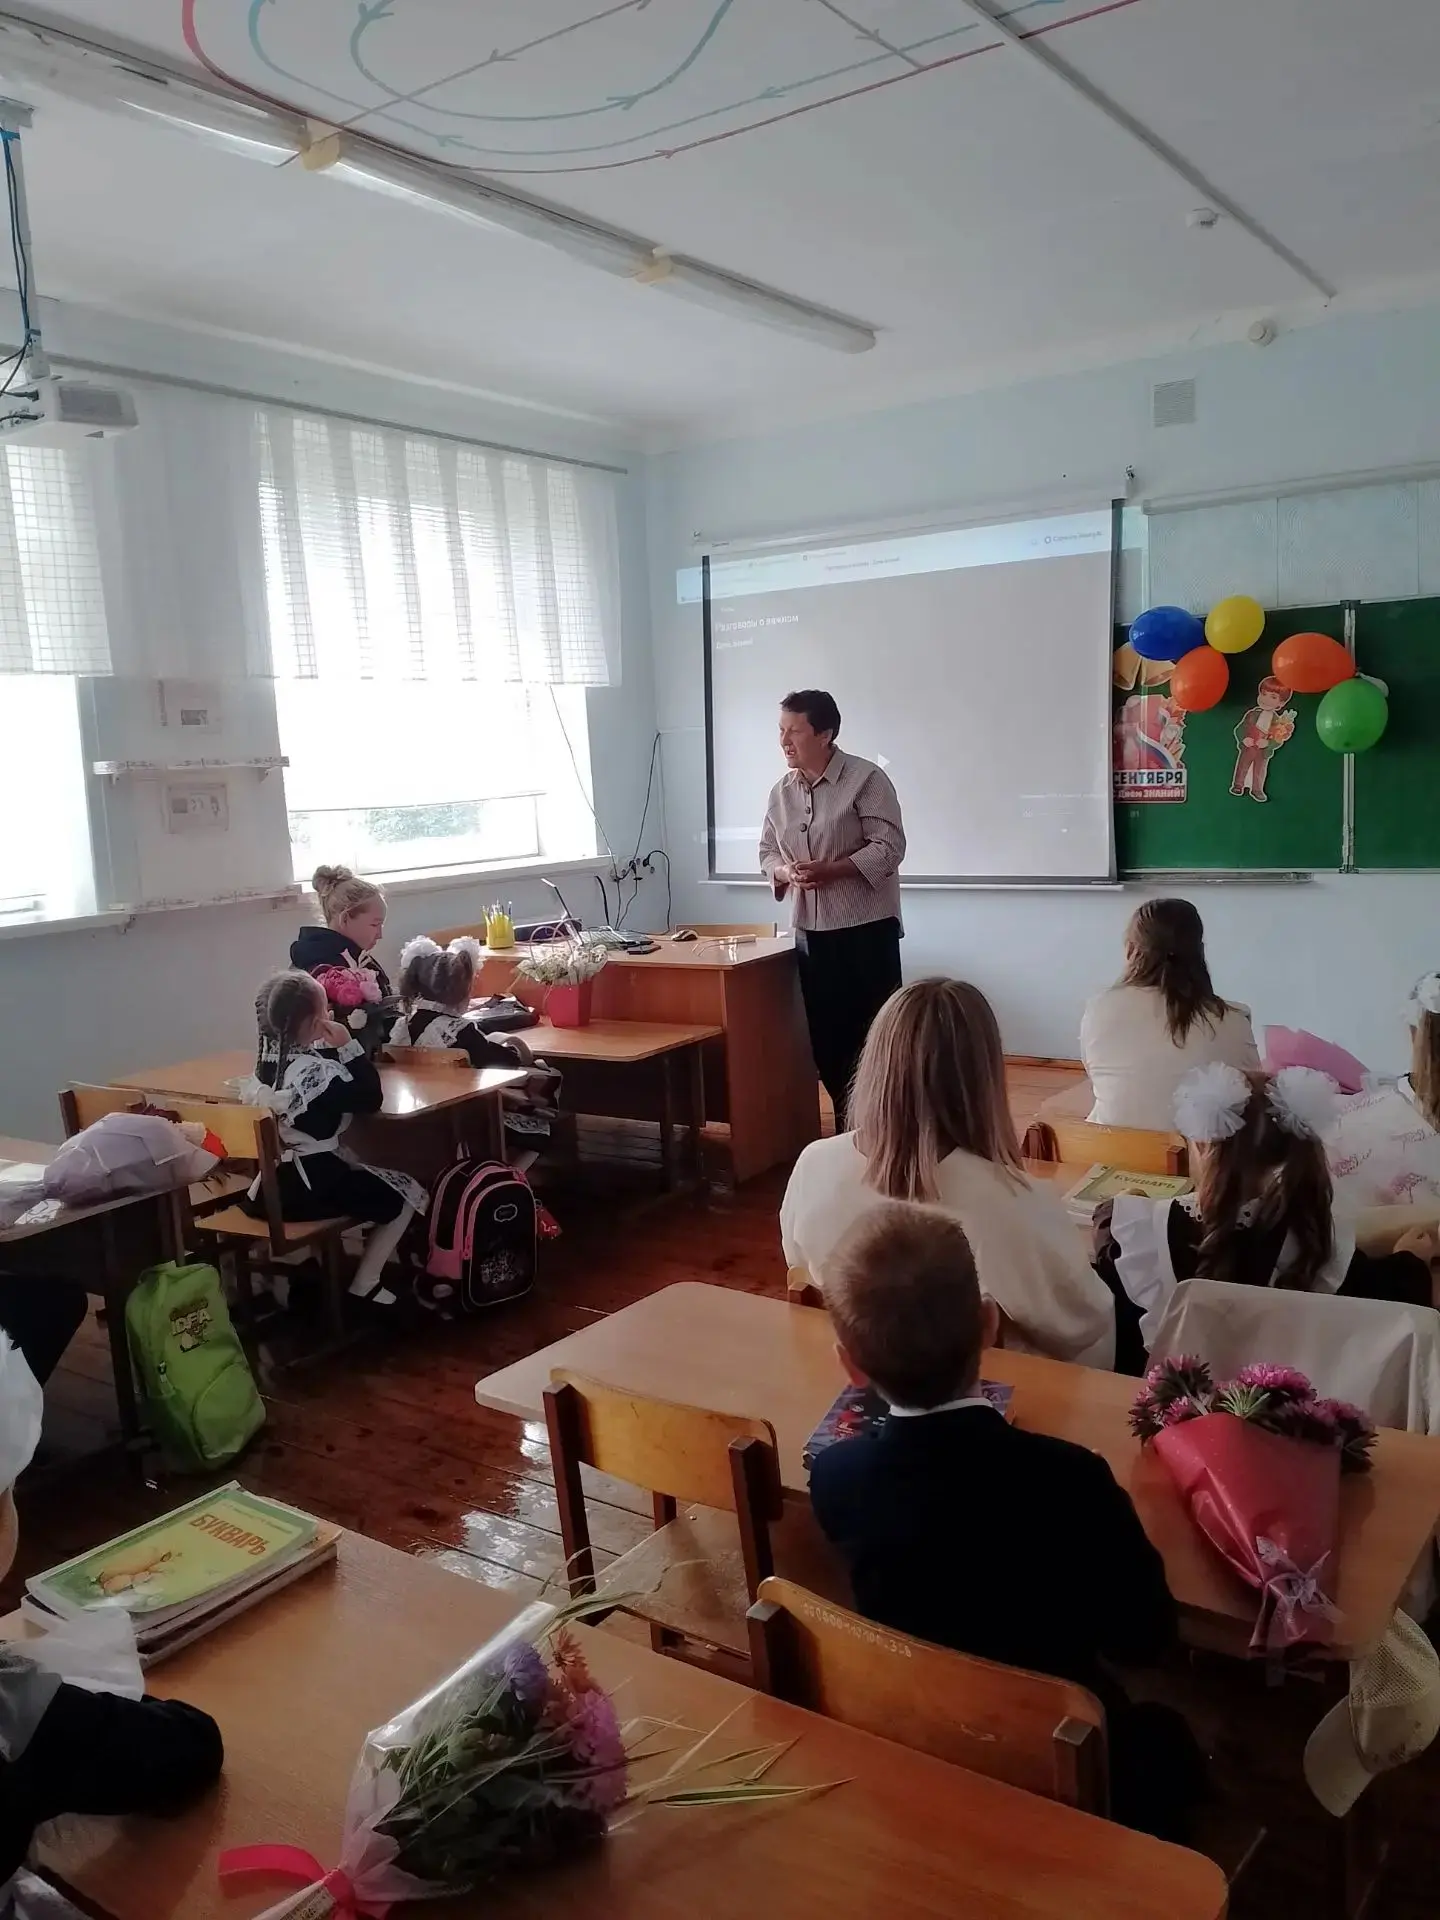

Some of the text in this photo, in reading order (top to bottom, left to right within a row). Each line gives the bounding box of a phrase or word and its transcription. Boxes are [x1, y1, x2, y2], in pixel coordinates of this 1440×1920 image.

[1114, 772, 1183, 784] СЕНТЯБРЯ
[1143, 787, 1184, 798] ЗНАНИЙ!
[189, 1513, 271, 1555] БУКВАРЬ
